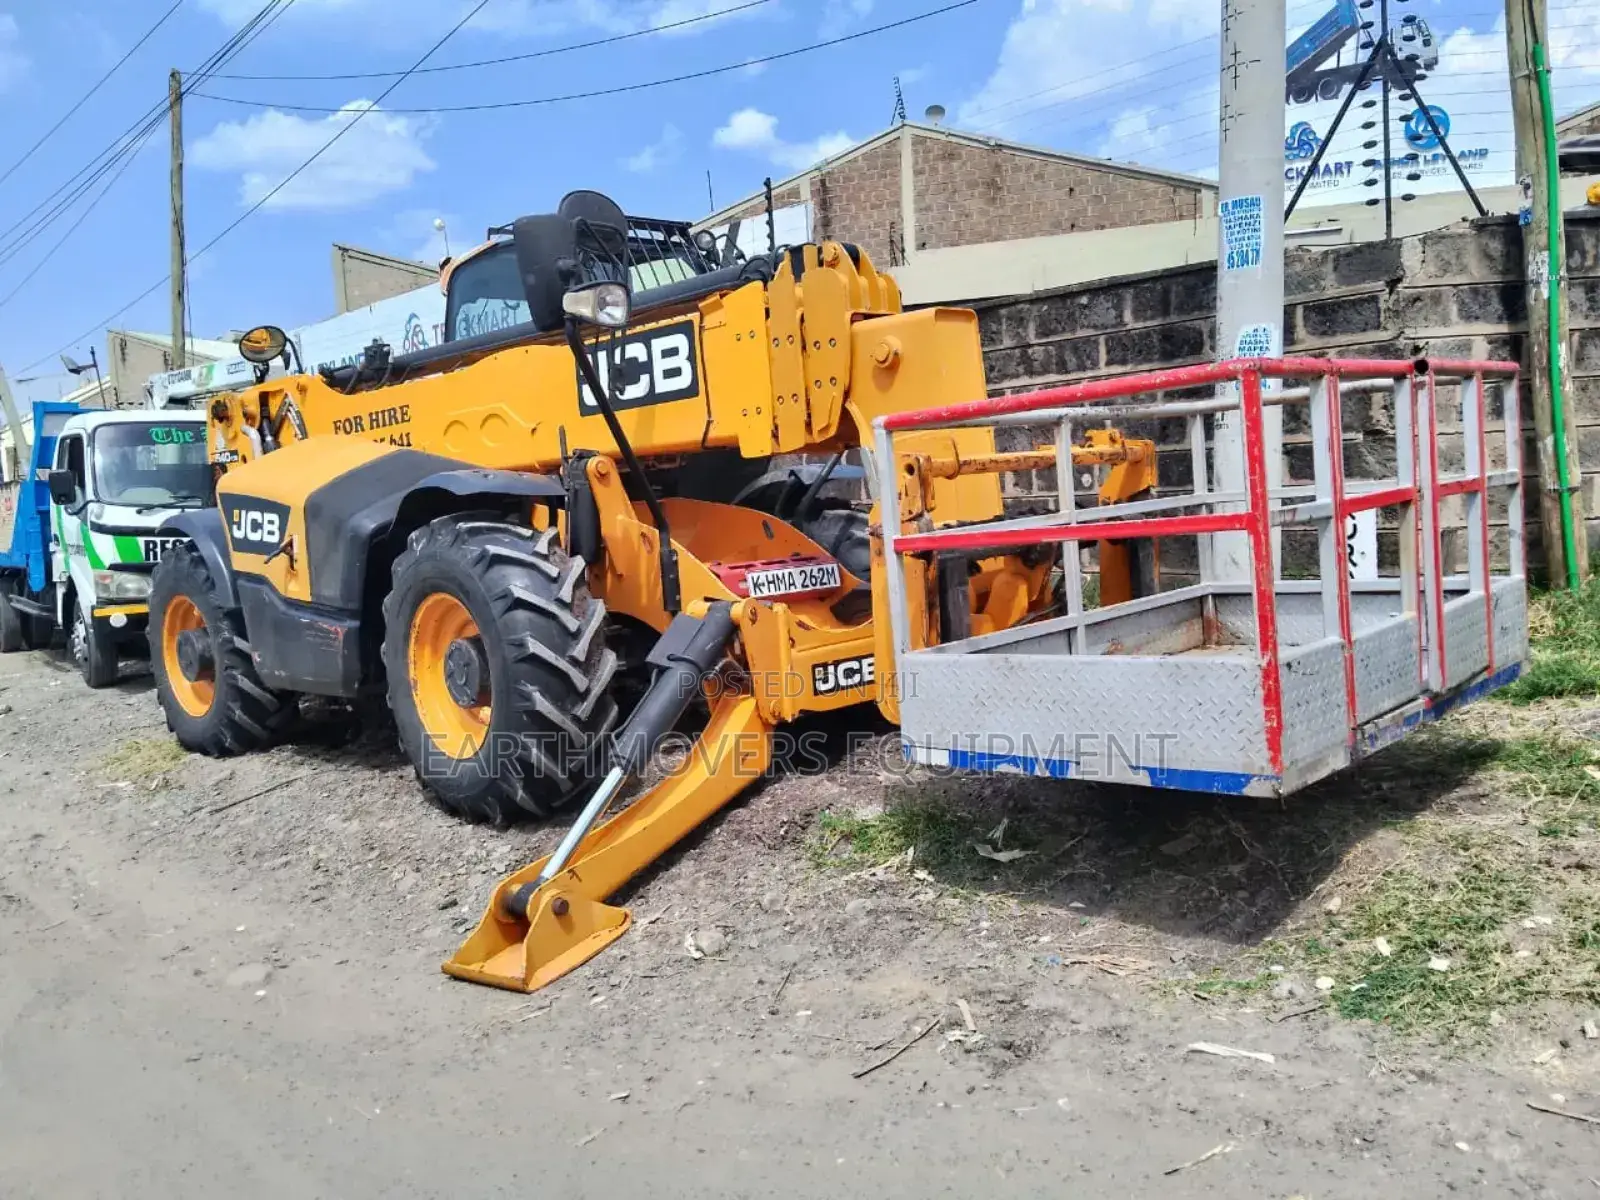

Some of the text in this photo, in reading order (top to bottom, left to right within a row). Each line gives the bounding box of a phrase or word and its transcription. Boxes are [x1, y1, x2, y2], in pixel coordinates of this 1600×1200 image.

[581, 333, 693, 407] JCB
[149, 427, 195, 444] The
[332, 404, 411, 435] FOR HIRE
[232, 509, 280, 543] JCB
